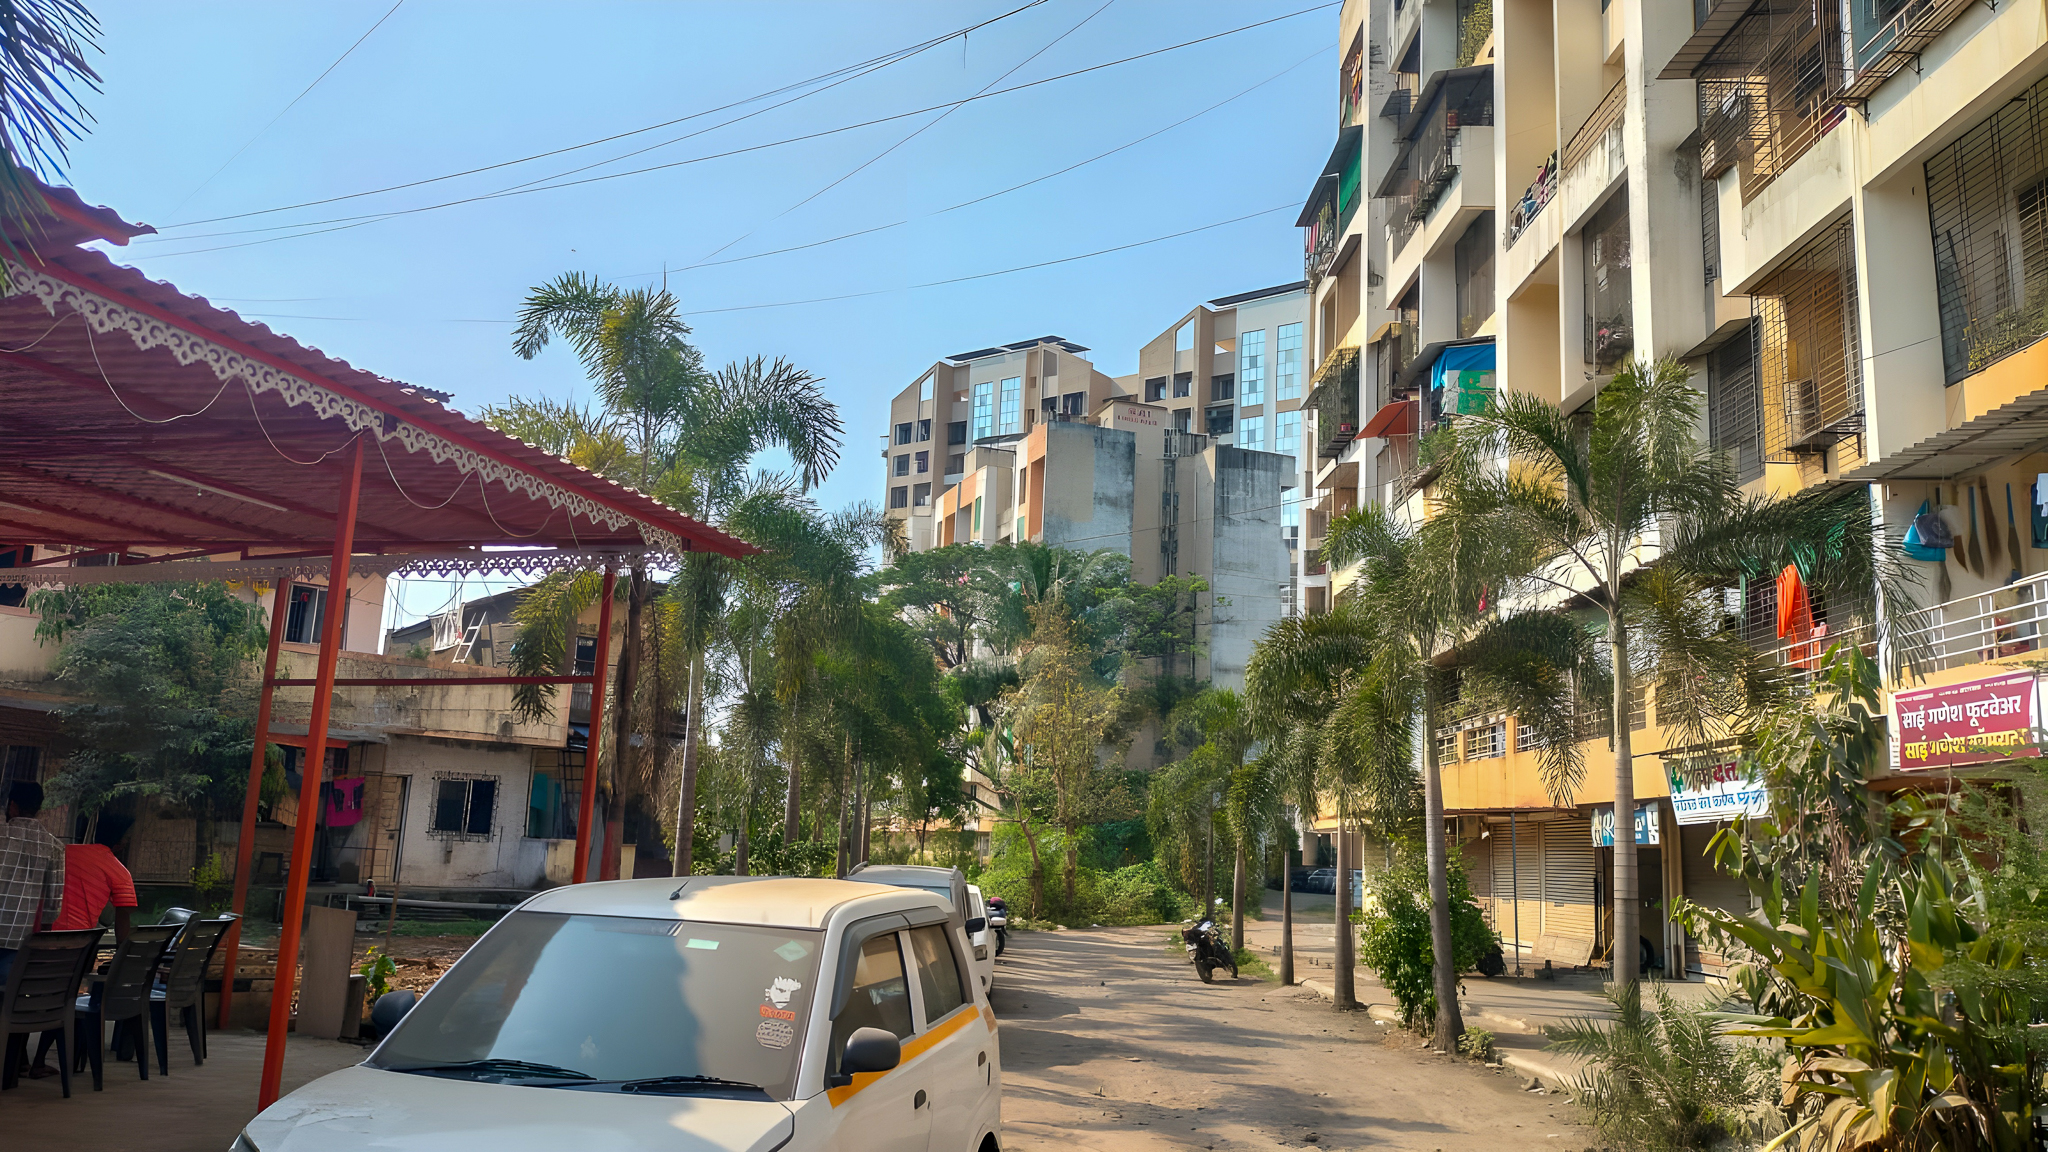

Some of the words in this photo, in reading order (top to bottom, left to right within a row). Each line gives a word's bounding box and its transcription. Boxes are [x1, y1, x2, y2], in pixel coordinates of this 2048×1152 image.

[1928, 701, 1963, 724] गणेश
[1965, 693, 2021, 727] फूटवेअर
[1930, 732, 1966, 756] गणेश
